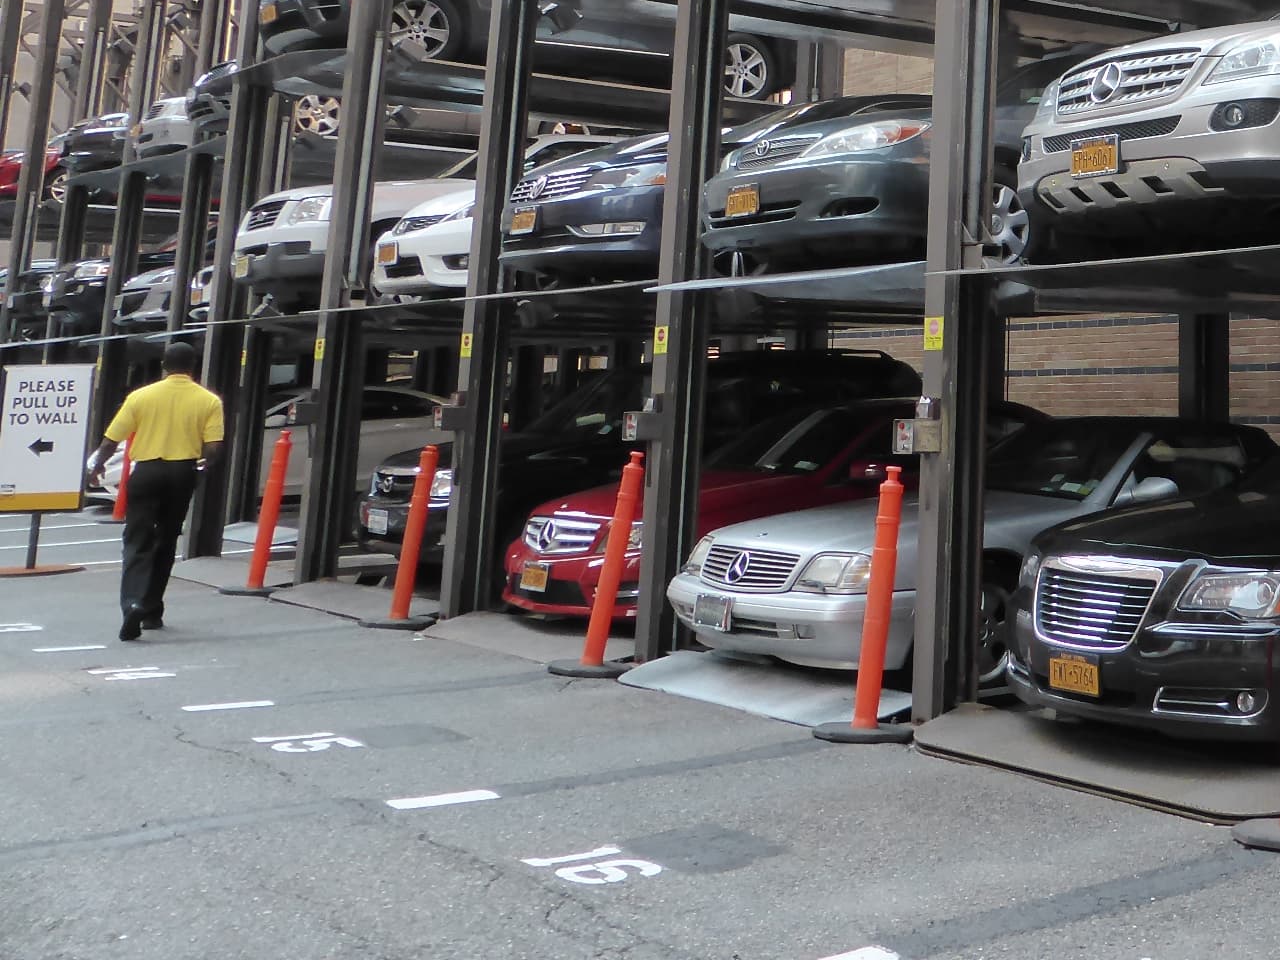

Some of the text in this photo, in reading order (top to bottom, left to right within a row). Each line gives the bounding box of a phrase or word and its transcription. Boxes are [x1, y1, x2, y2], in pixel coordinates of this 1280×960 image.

[19, 380, 75, 393] PLEASE
[12, 396, 77, 409] PULL UP
[9, 412, 78, 425] TO WALL
[251, 732, 368, 753] 15
[519, 843, 664, 886] 16
